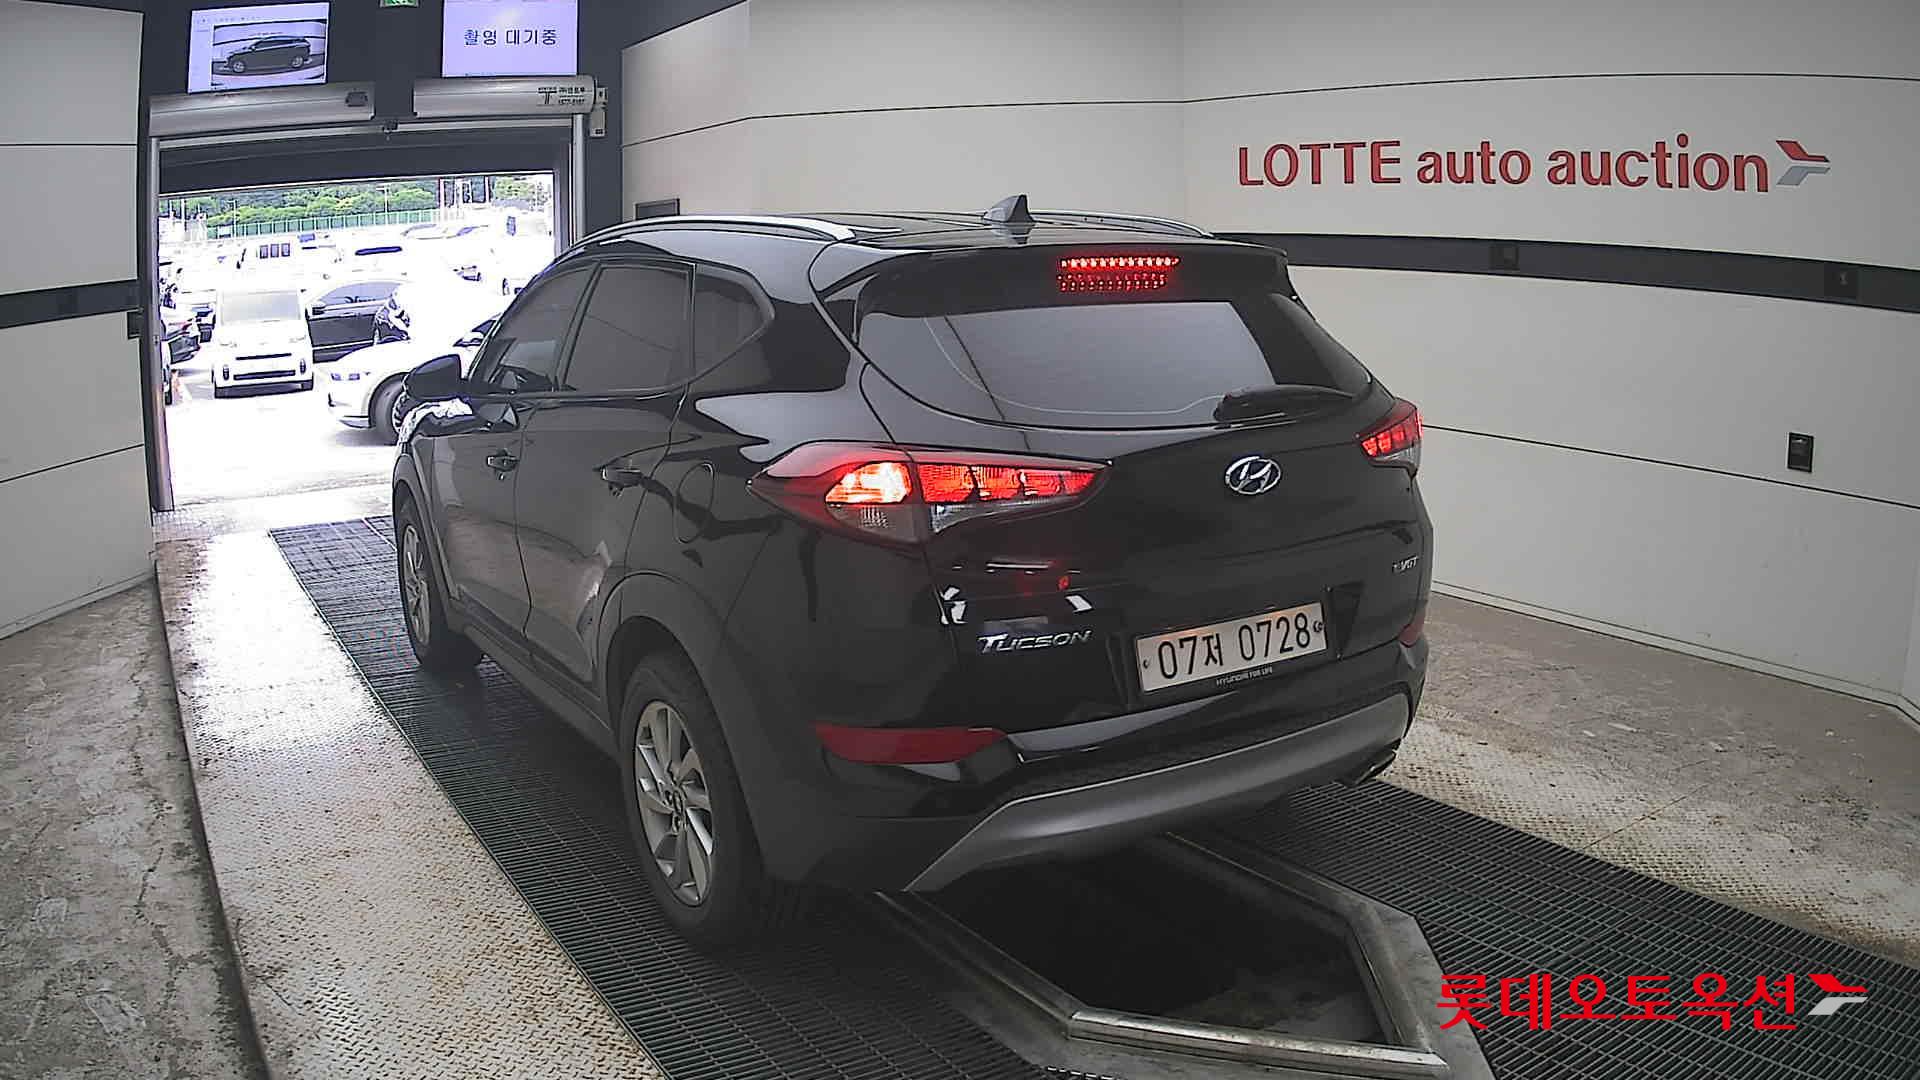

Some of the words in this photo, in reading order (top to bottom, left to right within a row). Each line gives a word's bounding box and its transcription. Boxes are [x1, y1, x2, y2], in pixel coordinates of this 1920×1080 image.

[505, 29, 557, 46] 대기중
[1239, 140, 1400, 186] LOTTE
[1417, 141, 1532, 185] auto
[1547, 133, 1769, 192] auction
[978, 630, 1092, 654] TUCSON
[1157, 632, 1224, 680] 07저
[1238, 611, 1311, 662] 0728
